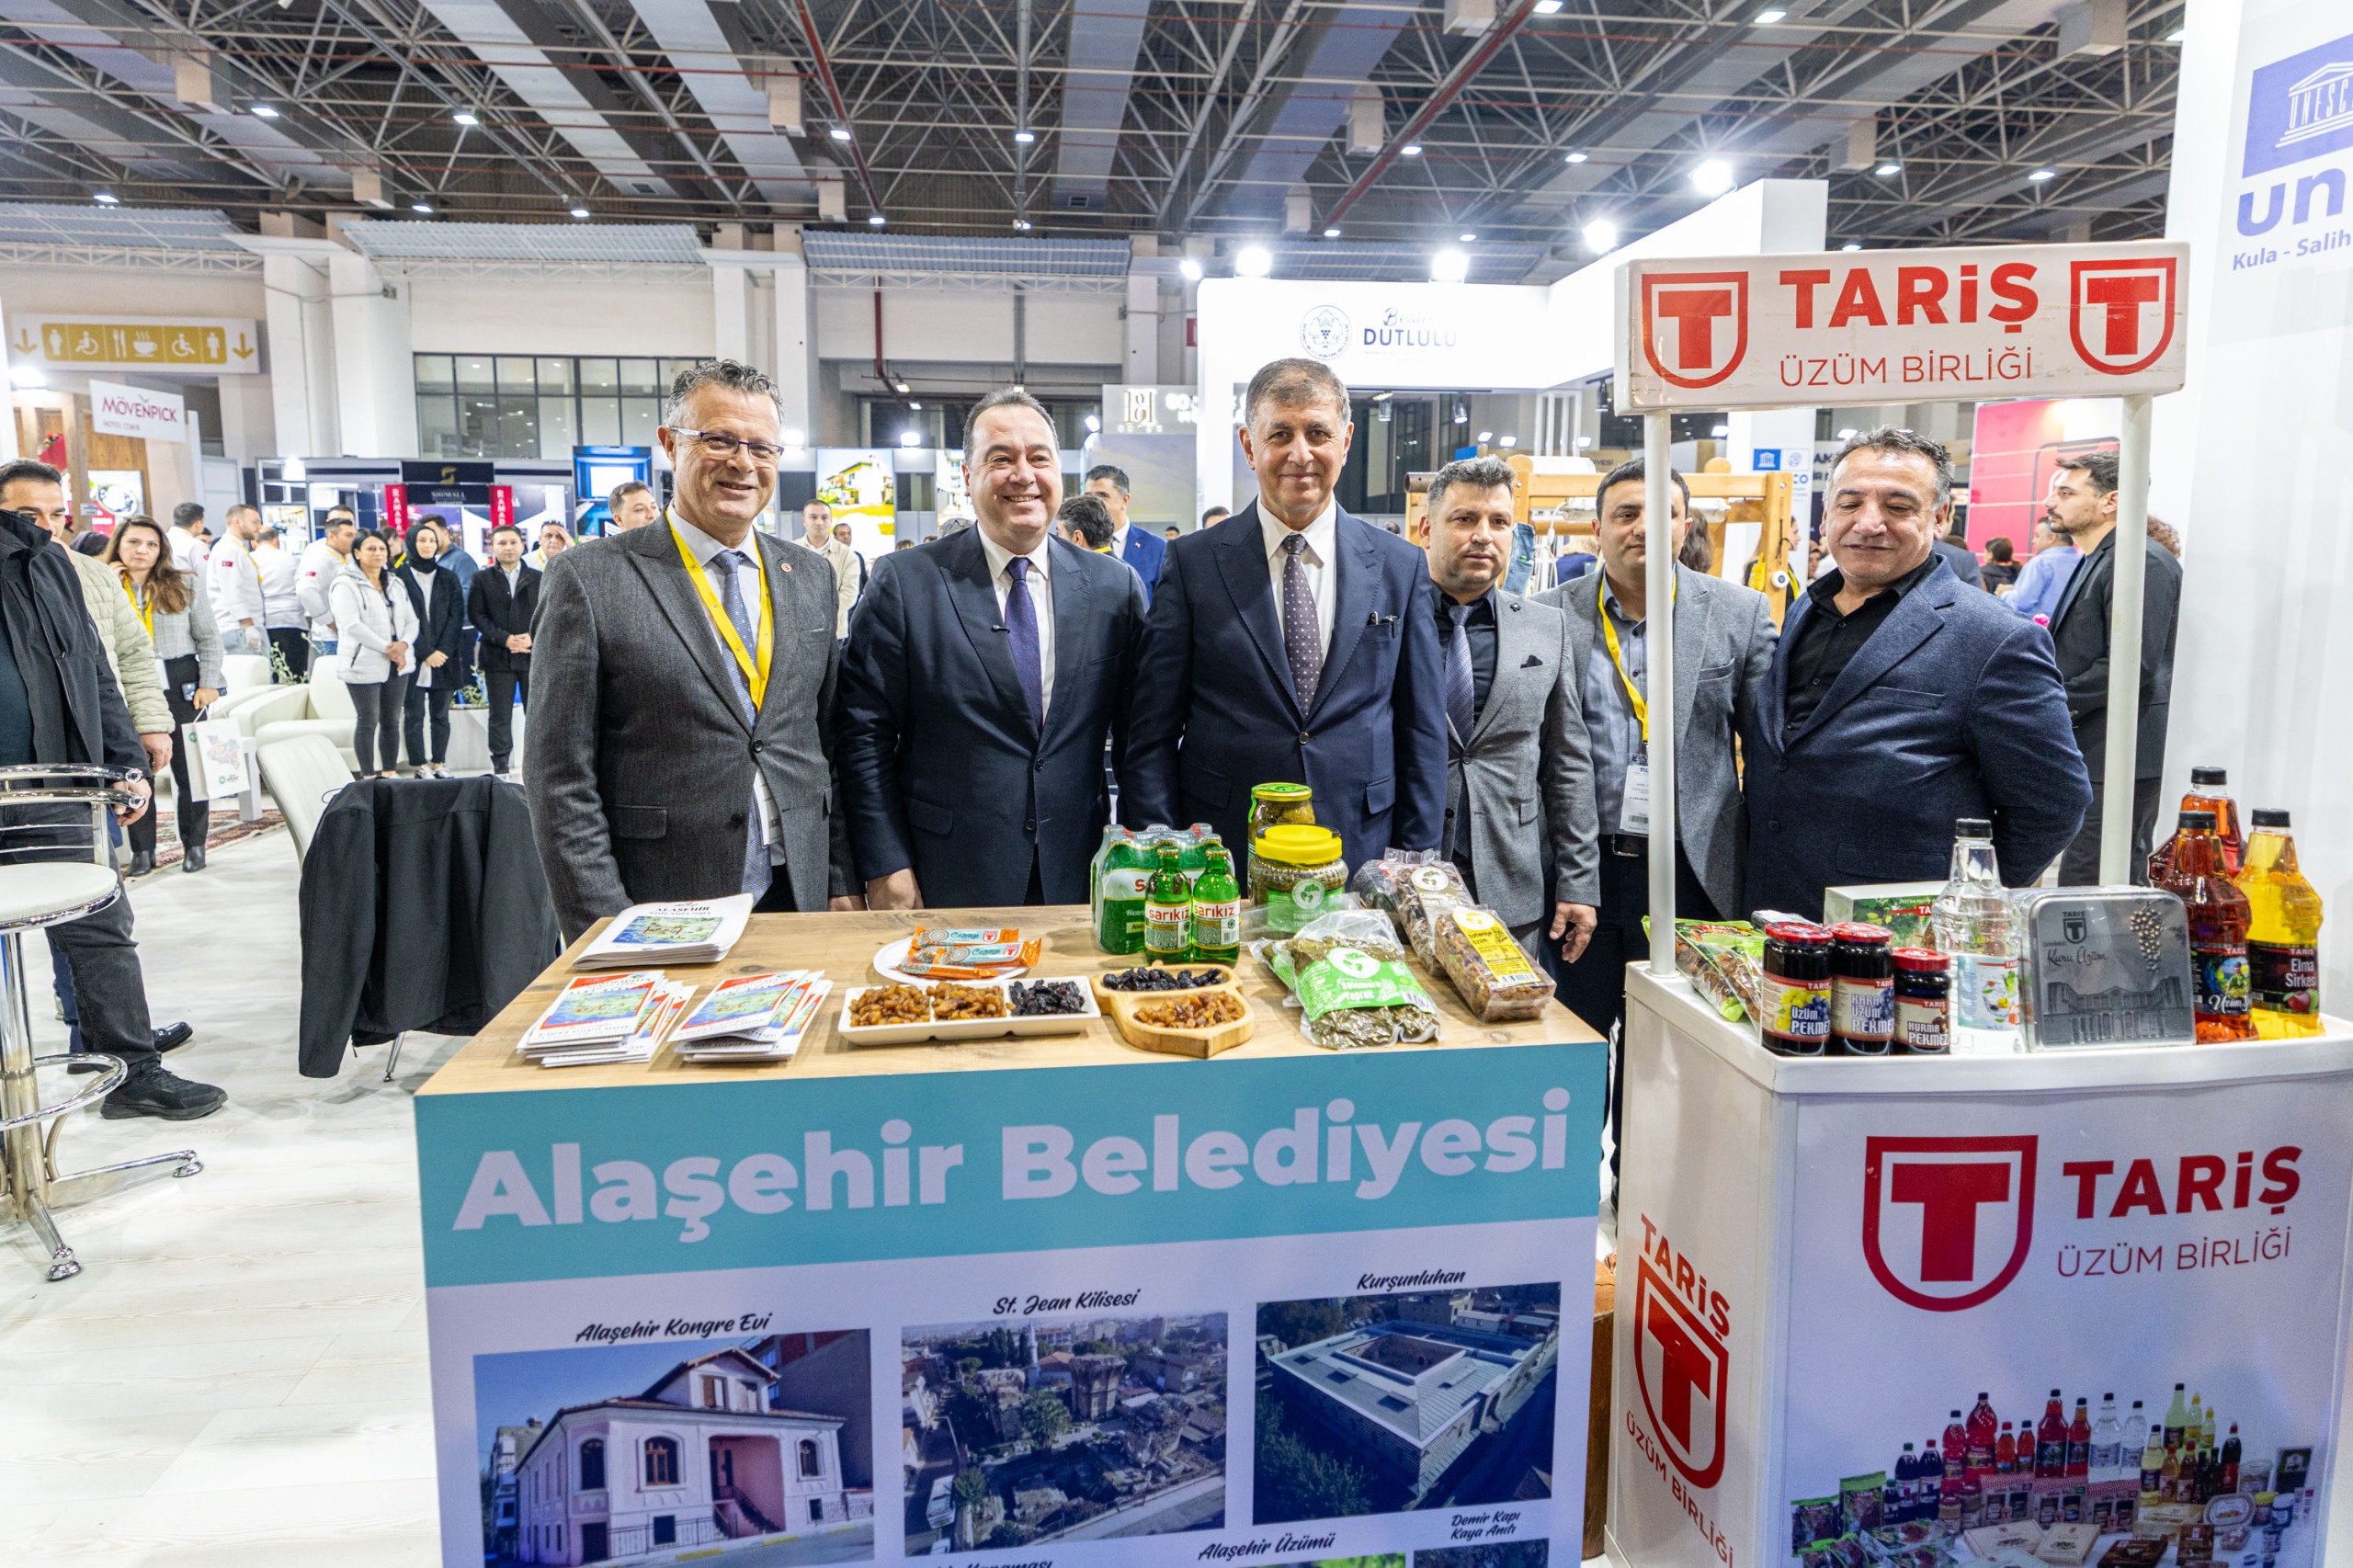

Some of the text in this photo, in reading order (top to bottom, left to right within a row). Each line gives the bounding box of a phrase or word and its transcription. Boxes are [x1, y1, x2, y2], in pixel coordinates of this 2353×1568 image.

[2233, 247, 2277, 271] Kula
[2296, 230, 2351, 257] Salih
[1364, 328, 1456, 347] DUTLULU
[1780, 346, 2031, 387] ÜZÜM BİRLİĞİ
[102, 396, 177, 423] MÖVENPICK
[497, 490, 506, 526] RAMAD
[2291, 958, 2314, 972] Elma
[1851, 994, 1880, 1006] KARA
[1908, 1022, 1939, 1033] HURMA
[452, 1087, 1571, 1243] Alaşehir Belediyesi
[2058, 1226, 2291, 1278] ÜZÜM BİRLİĞİ
[1357, 1266, 1466, 1292] Kurşunluhan
[993, 1289, 1142, 1315] St. Jean Kilisesi
[575, 1312, 773, 1345] Alaşehir Kongre Evi
[1626, 1409, 1734, 1568] ÜZÜM BİRLİĞİ
[1450, 1510, 1520, 1527] Demir Kapı
[1450, 1523, 1517, 1541] Kaya Anıtı
[1198, 1531, 1336, 1561] Alaşehir Üzümü
